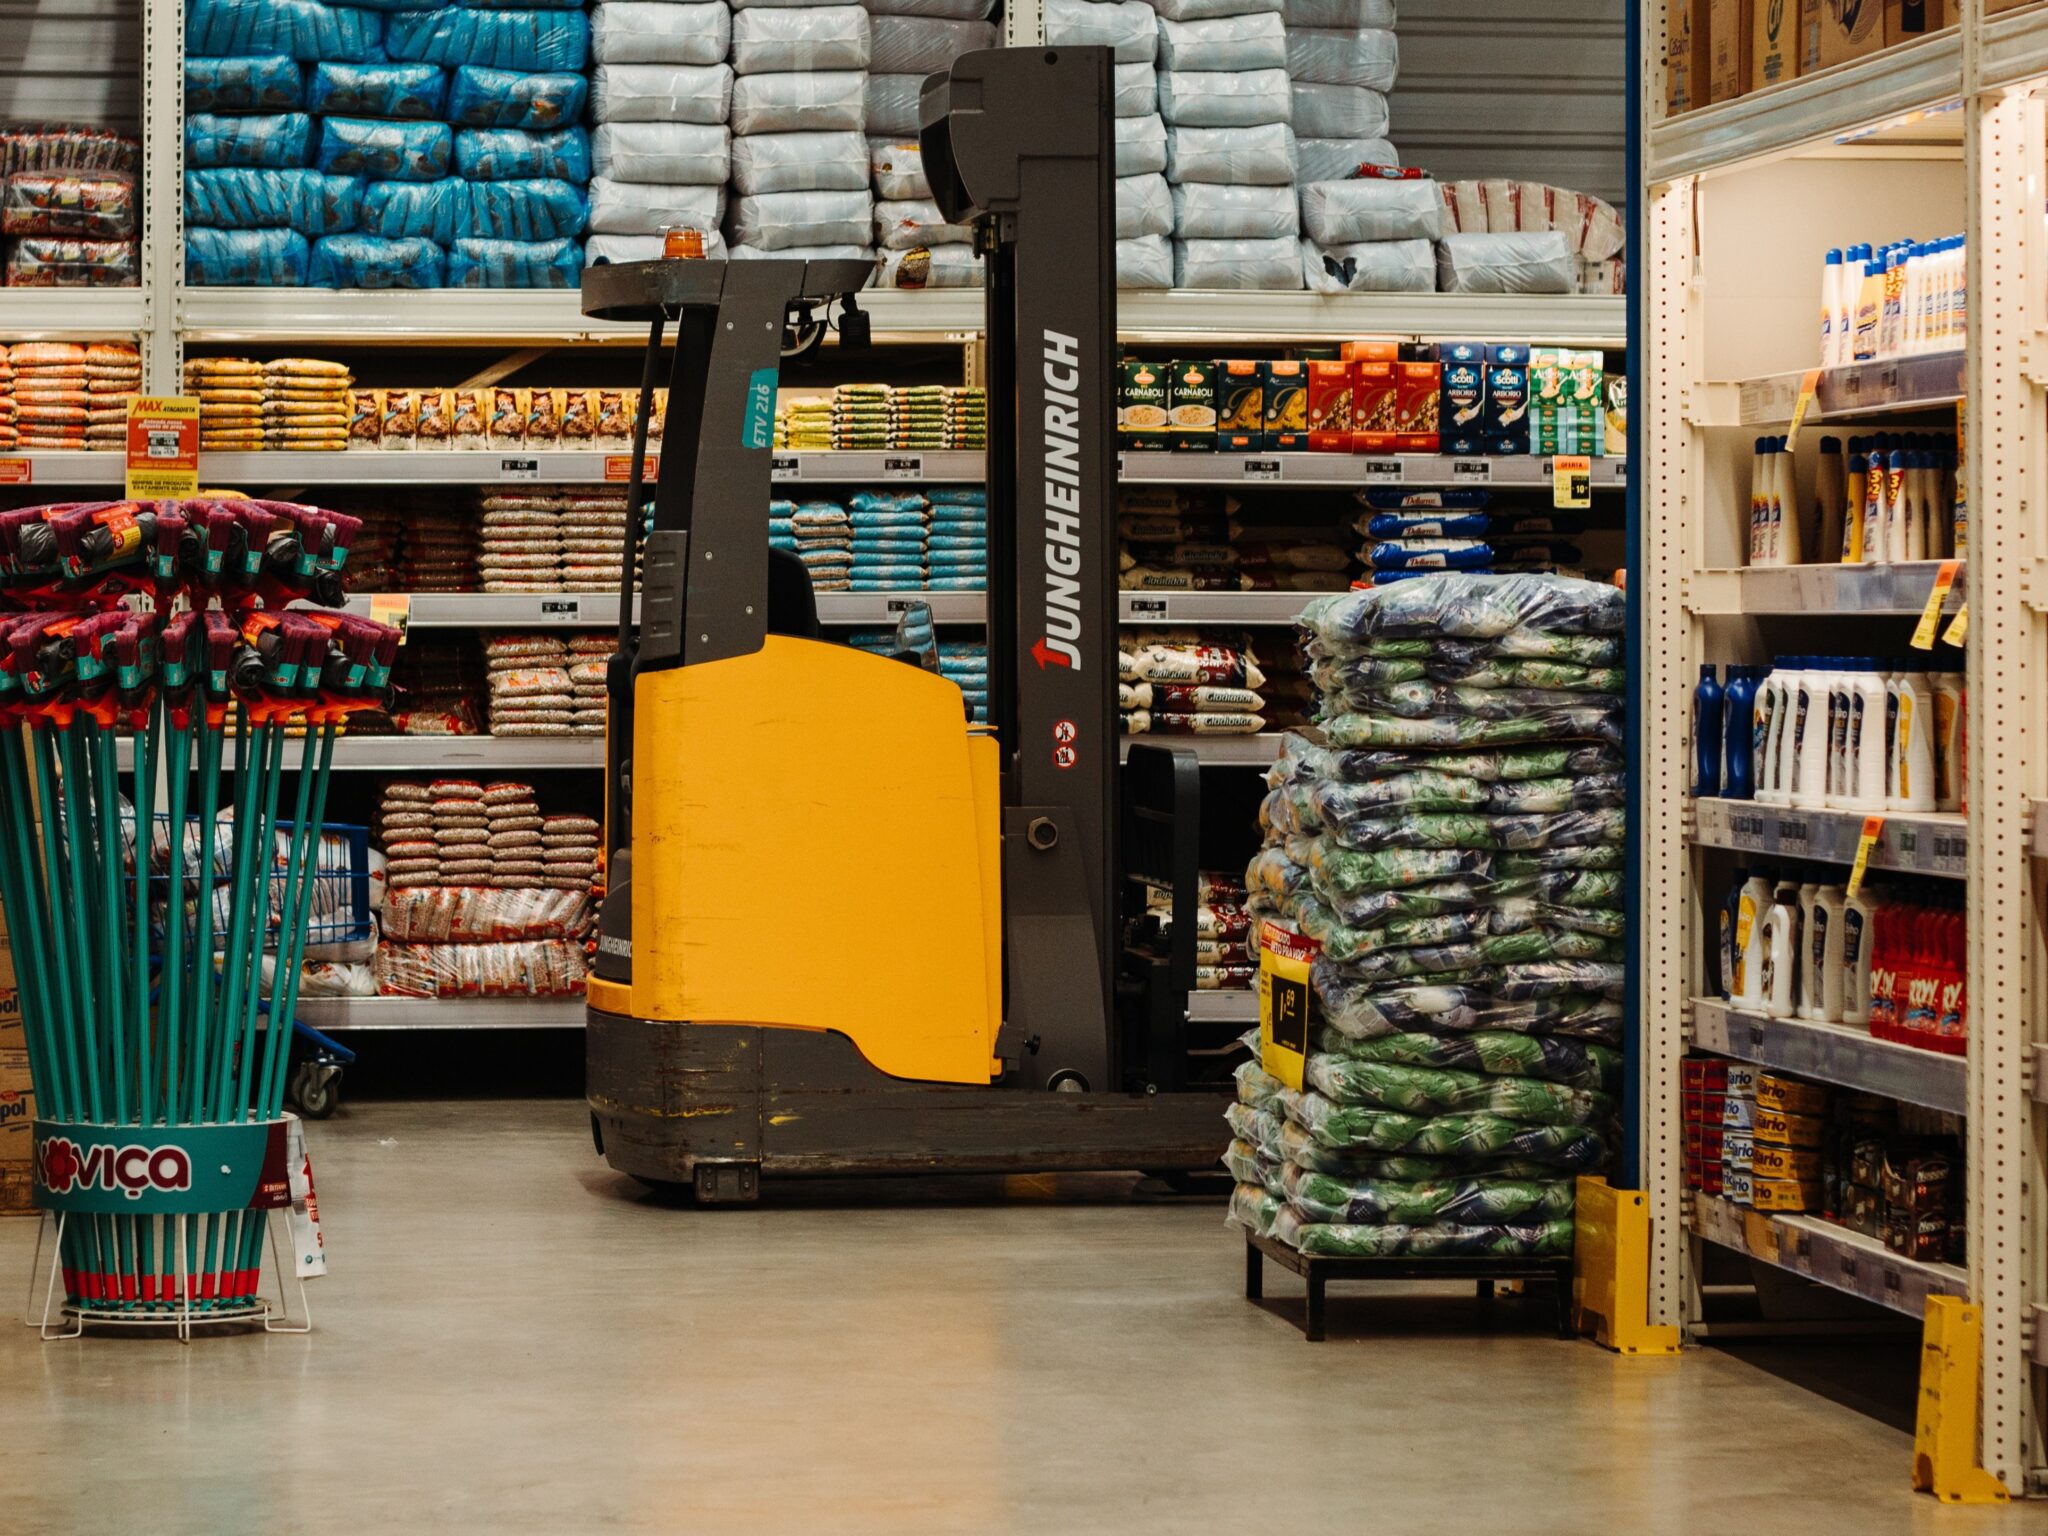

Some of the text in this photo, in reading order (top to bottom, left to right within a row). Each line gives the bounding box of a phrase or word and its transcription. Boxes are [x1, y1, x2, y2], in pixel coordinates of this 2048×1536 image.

[1451, 374, 1474, 384] Scotti
[1496, 375, 1519, 385] Scotti
[1124, 387, 1164, 397] CARNAROLI
[1174, 387, 1213, 397] CARNAROLI
[1448, 389, 1477, 397] ARBORIO
[1492, 390, 1522, 398] ARBORIO
[132, 400, 162, 416] MAX
[753, 383, 771, 447] ETV 216
[1043, 329, 1081, 671] JUNGHEINRICH
[1142, 575, 1188, 586] Gladiador
